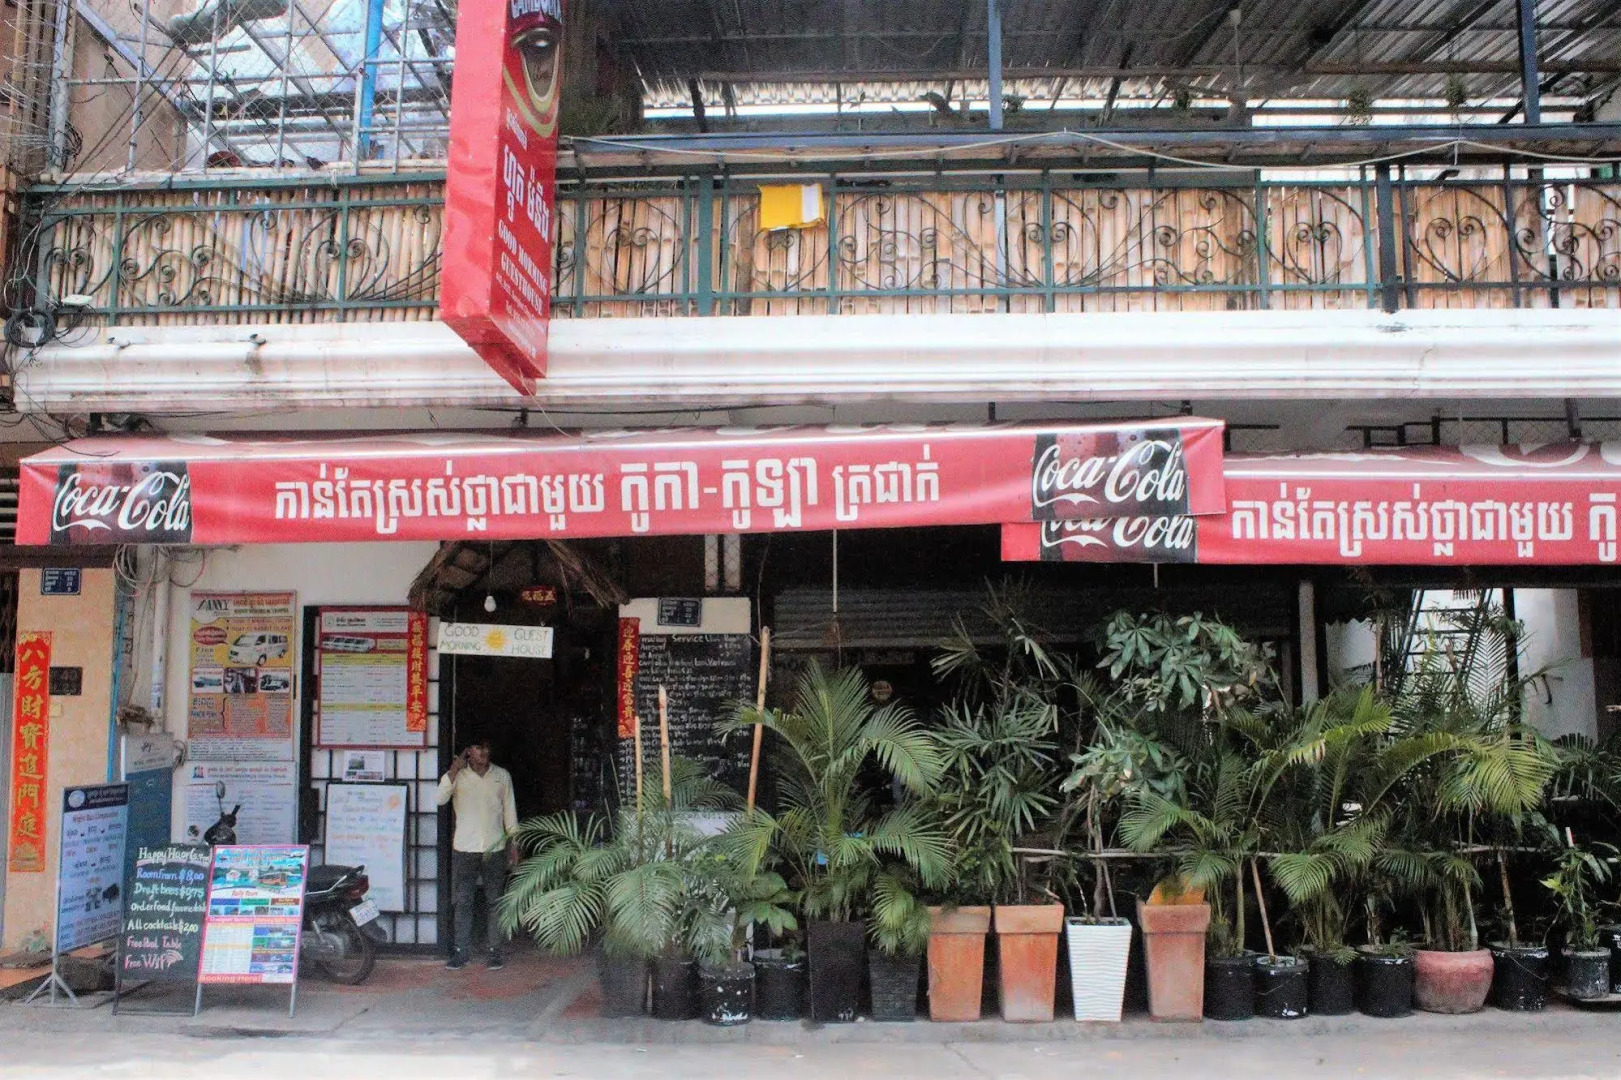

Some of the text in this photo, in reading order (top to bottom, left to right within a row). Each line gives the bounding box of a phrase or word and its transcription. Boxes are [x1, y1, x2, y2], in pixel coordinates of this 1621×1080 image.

[498, 218, 518, 256] GOOD
[518, 244, 548, 296] MORNING
[501, 251, 543, 317] GUESTHOUSE
[1032, 440, 1185, 508] Coca-Cola
[53, 471, 190, 532] Coca-Cola
[445, 626, 548, 641] GOOD GUEST
[440, 640, 547, 656] MORNING HOUSE
[139, 847, 166, 865] Happy
[136, 868, 160, 879] Room
[134, 882, 160, 900] Draft
[127, 918, 142, 930] All
[127, 936, 142, 948] Free
[143, 937, 159, 948] Pool
[124, 954, 141, 969] Free
